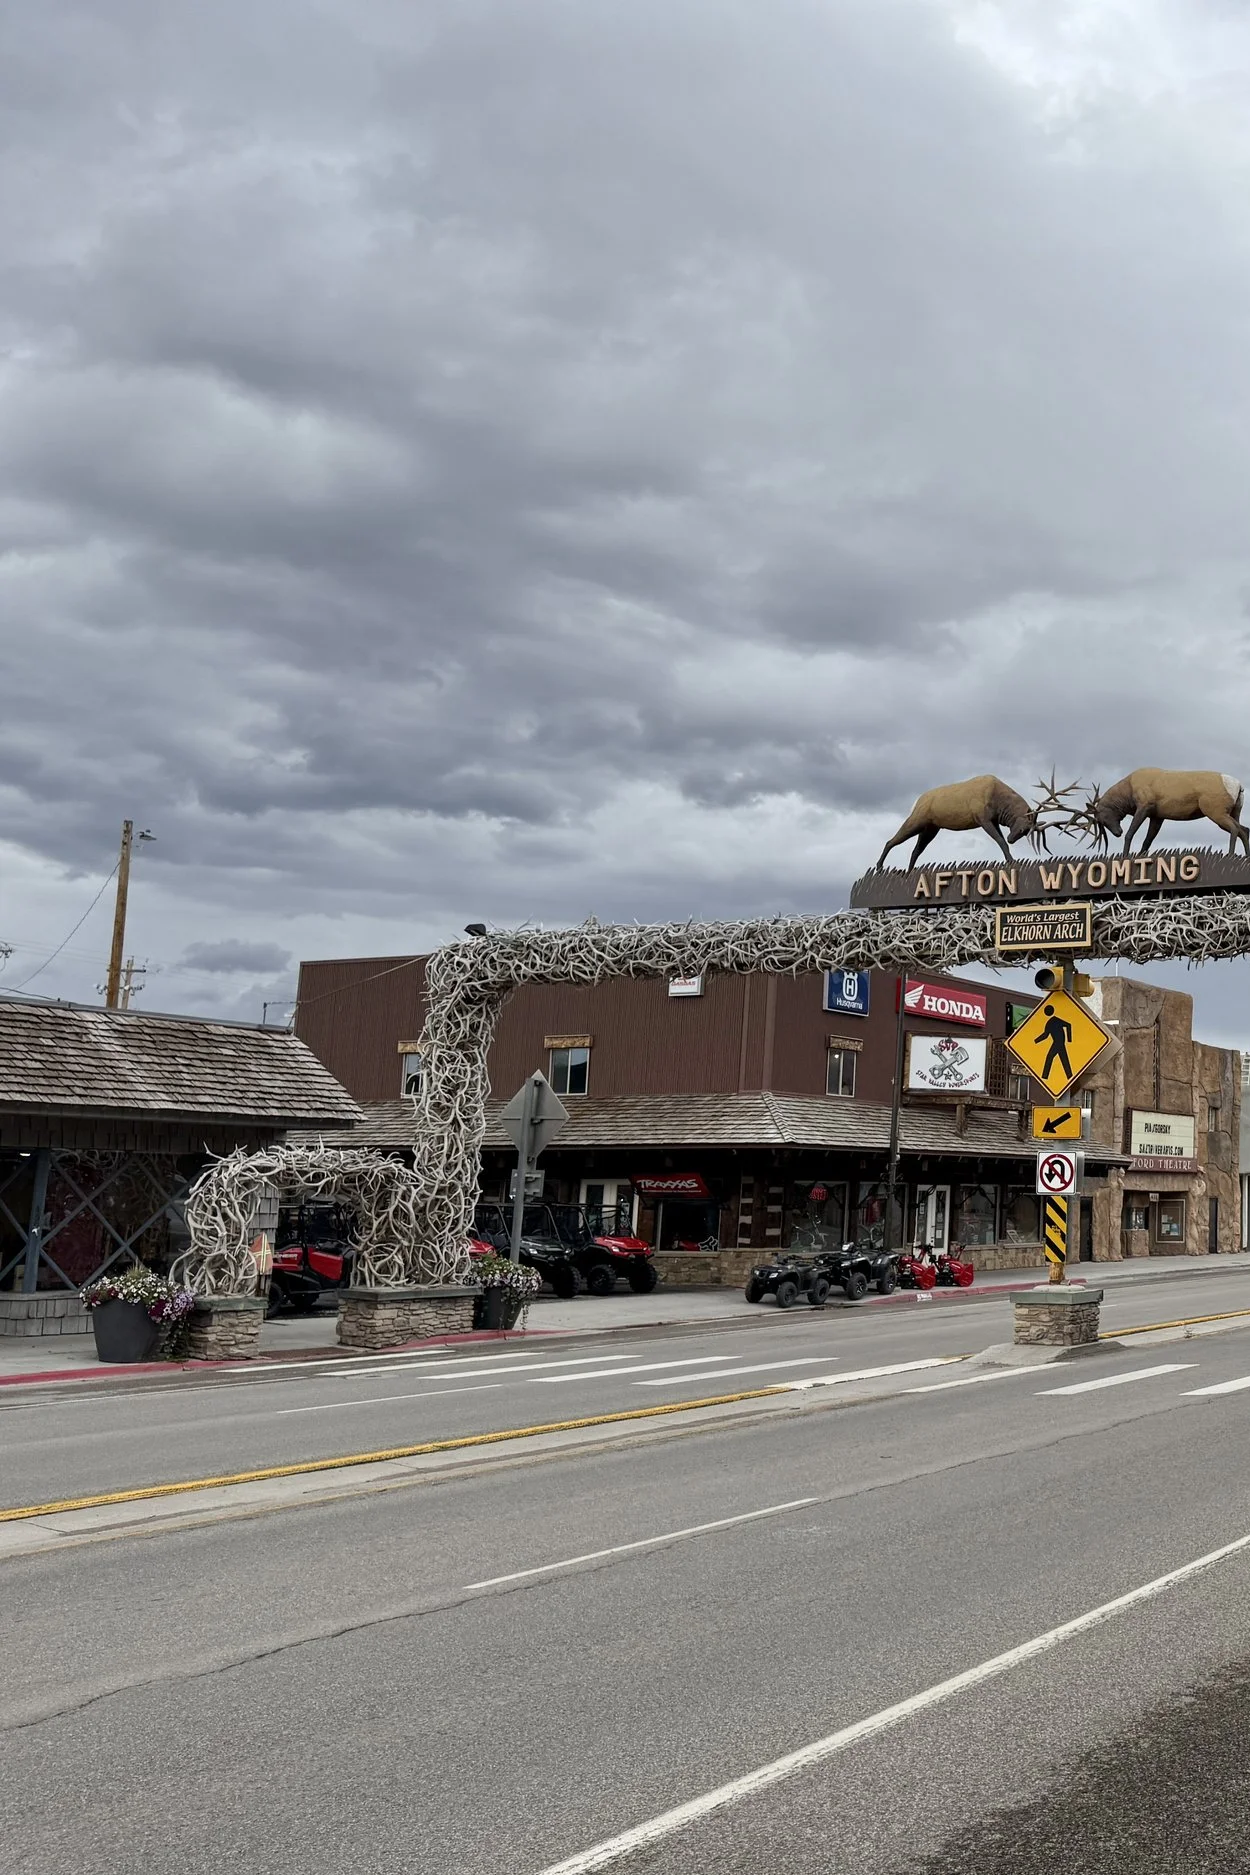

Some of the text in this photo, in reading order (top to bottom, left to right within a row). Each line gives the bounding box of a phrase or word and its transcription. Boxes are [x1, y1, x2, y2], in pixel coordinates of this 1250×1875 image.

[914, 855, 1200, 898] AFTON WYOMING
[1006, 911, 1079, 923] World's Largest
[1001, 923, 1084, 941] ELKHORN ARCH
[836, 997, 863, 1010] Husqvarna
[923, 996, 985, 1021] HONDA
[1133, 1158, 1191, 1171] FORD THEATRE
[637, 1179, 698, 1189] TRAXXAS
